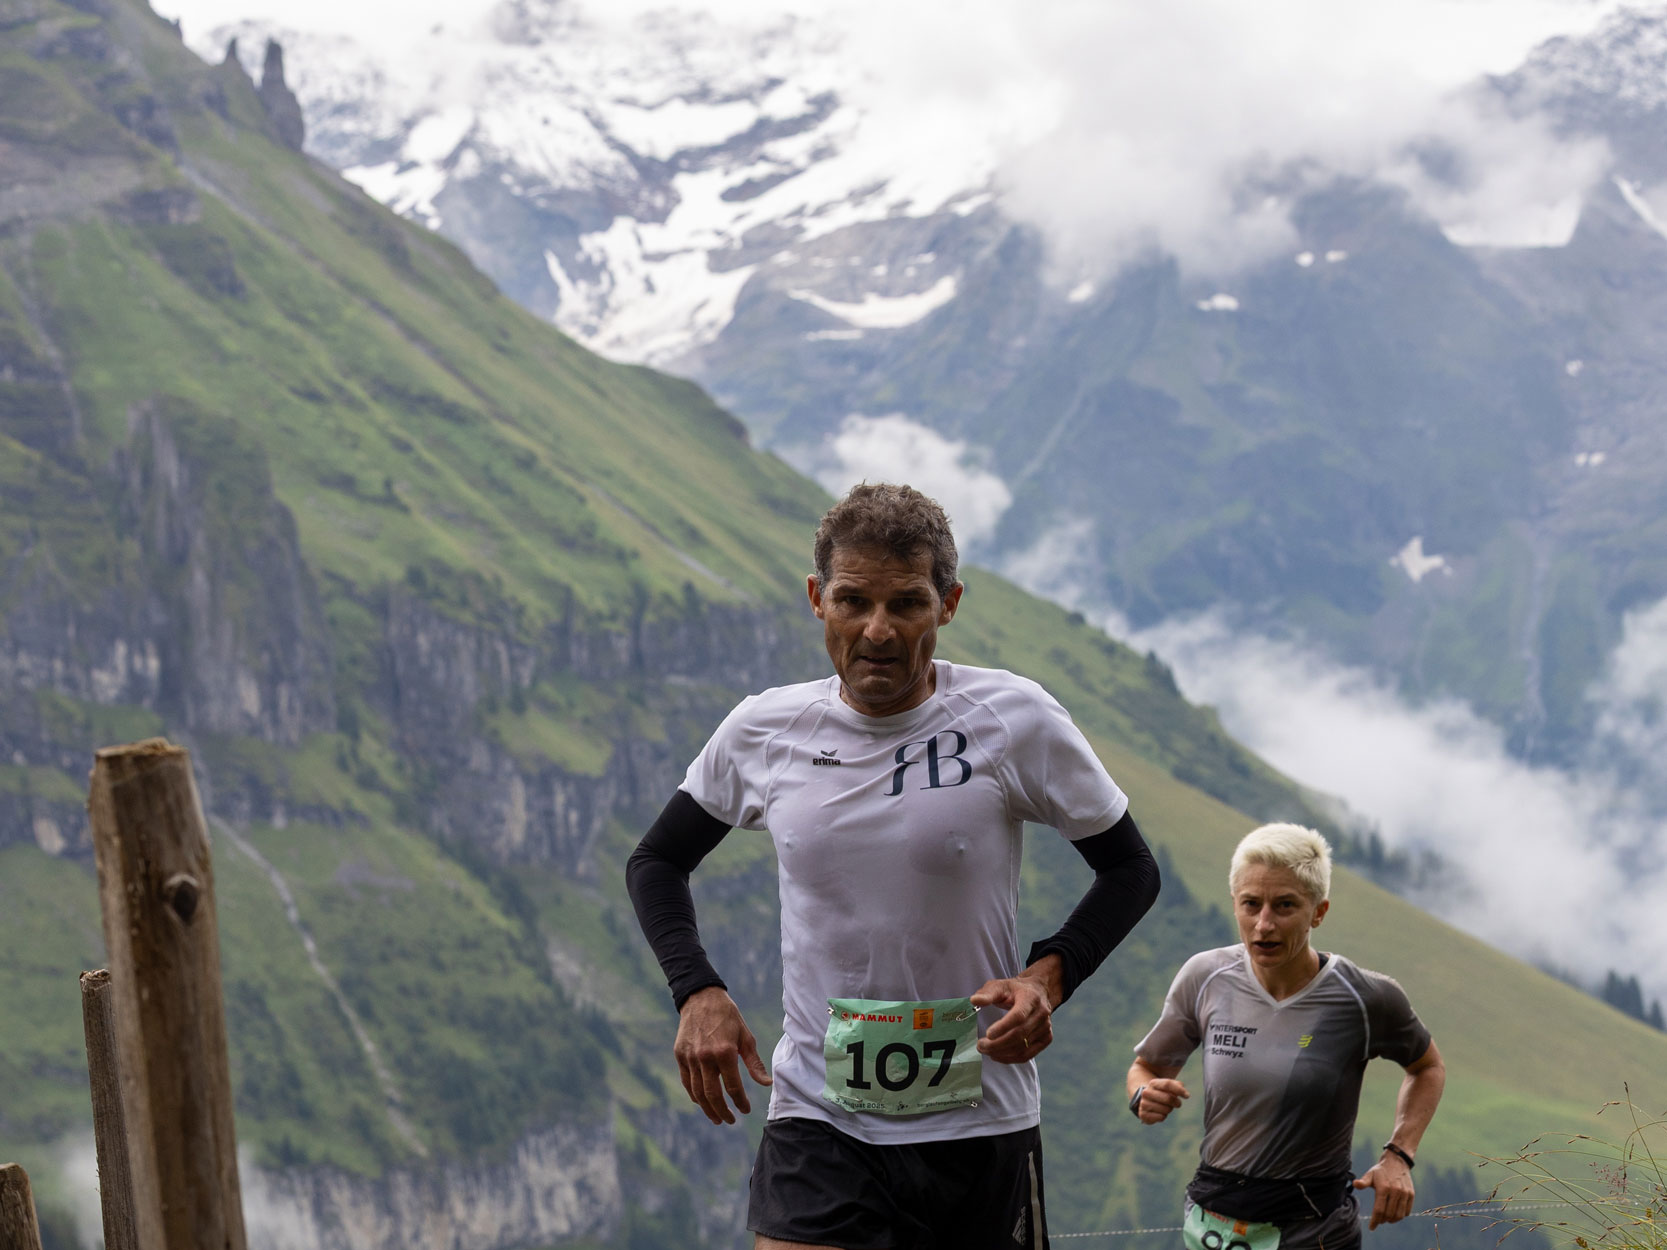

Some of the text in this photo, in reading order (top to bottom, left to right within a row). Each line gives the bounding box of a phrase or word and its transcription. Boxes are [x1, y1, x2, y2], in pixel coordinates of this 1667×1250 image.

[812, 756, 841, 766] erima
[852, 1012, 904, 1023] MAMMUT
[1213, 1034, 1247, 1048] MELI
[1211, 1047, 1244, 1059] Schwyz
[846, 1039, 957, 1092] 107
